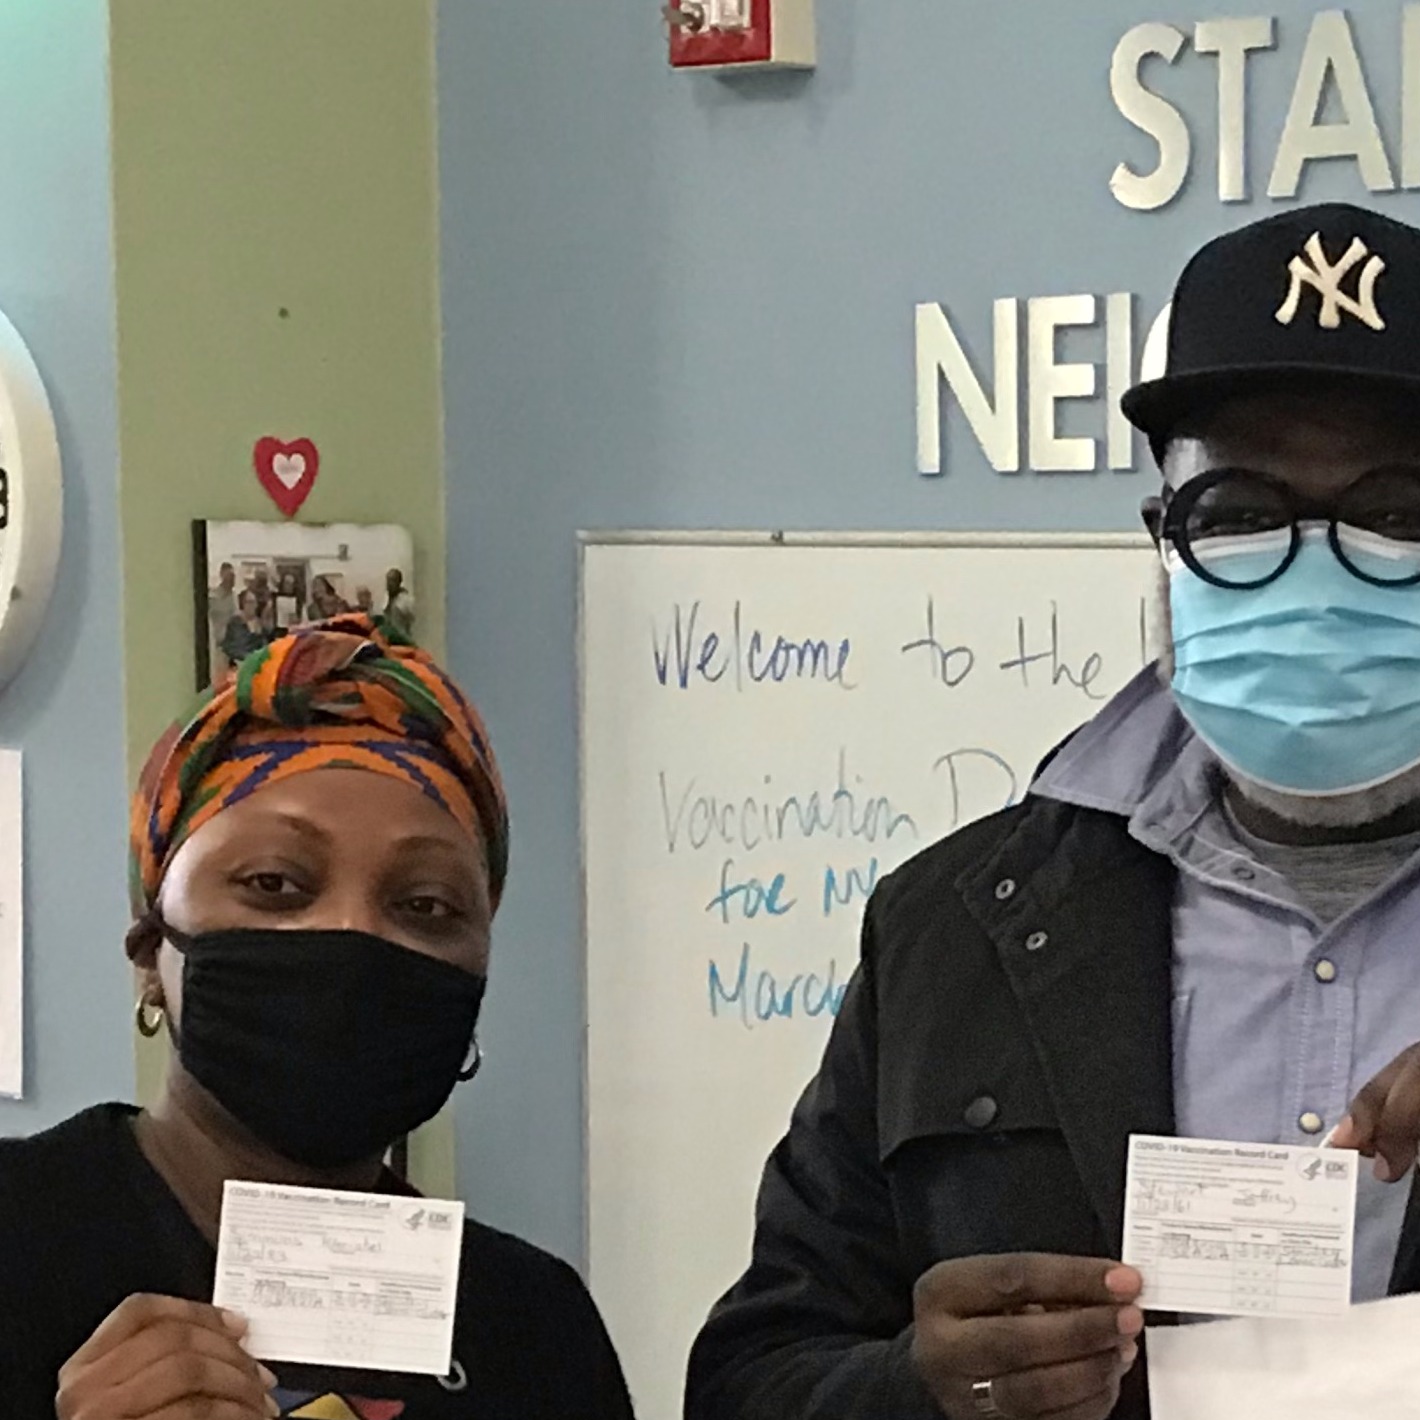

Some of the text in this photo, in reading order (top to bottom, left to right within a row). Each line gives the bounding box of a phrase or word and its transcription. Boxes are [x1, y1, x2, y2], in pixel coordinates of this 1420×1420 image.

[1274, 230, 1387, 331] NY
[652, 600, 858, 692] Welcome
[902, 594, 975, 687] to
[999, 599, 1108, 699] the
[658, 746, 920, 853] Vaccination
[1181, 1145, 1233, 1156] Vaccination
[1234, 1147, 1266, 1159] Record
[1268, 1150, 1290, 1161] Card
